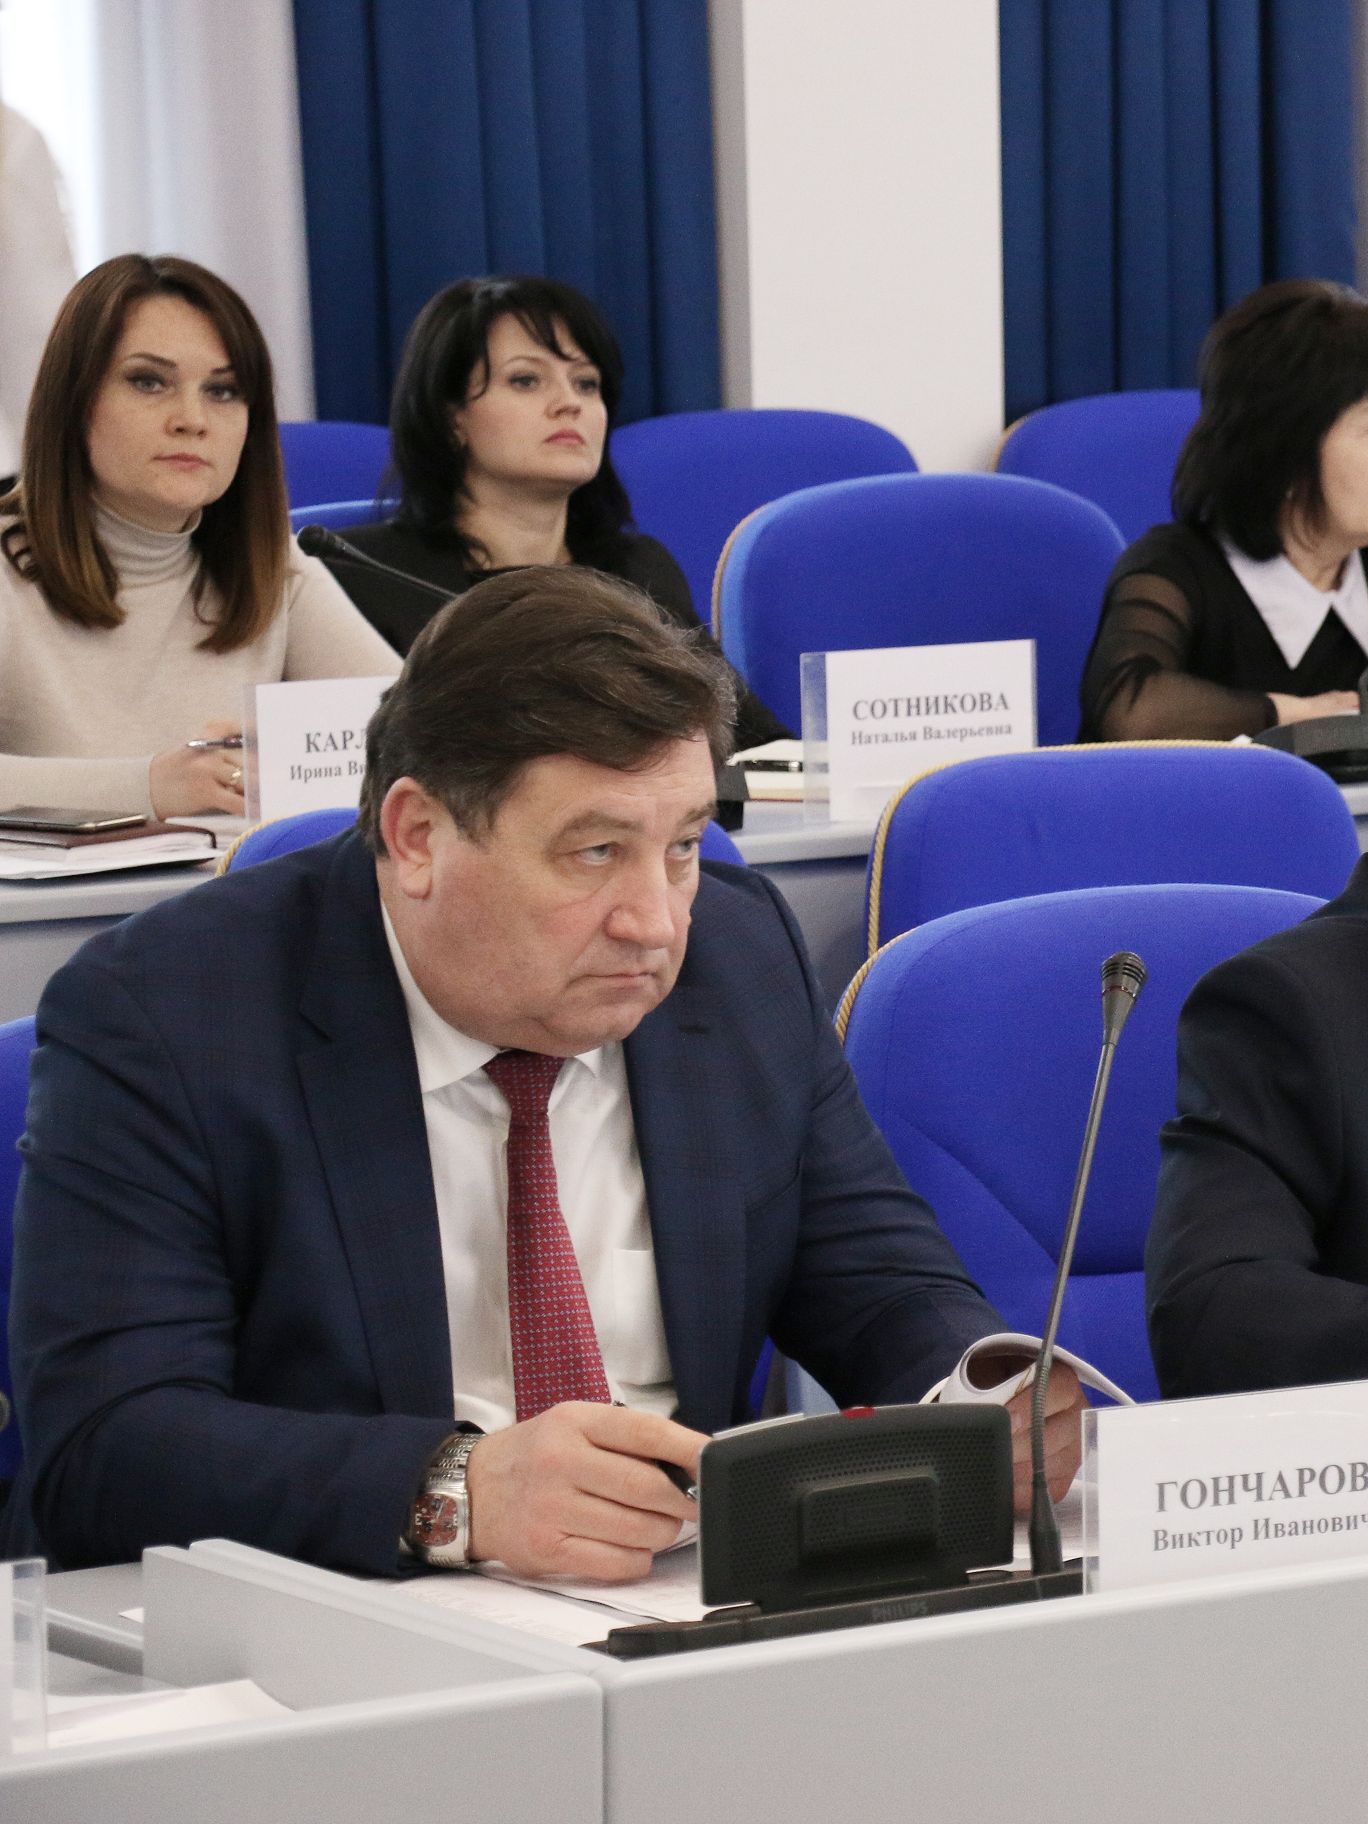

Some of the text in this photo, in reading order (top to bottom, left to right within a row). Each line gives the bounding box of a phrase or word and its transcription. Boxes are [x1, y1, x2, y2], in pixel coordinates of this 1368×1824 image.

[852, 691, 1010, 721] СОТНИКОВА
[850, 724, 1013, 746] Наталья Валерьевна
[290, 764, 342, 783] Ирина
[1153, 1523, 1244, 1552] Виктор
